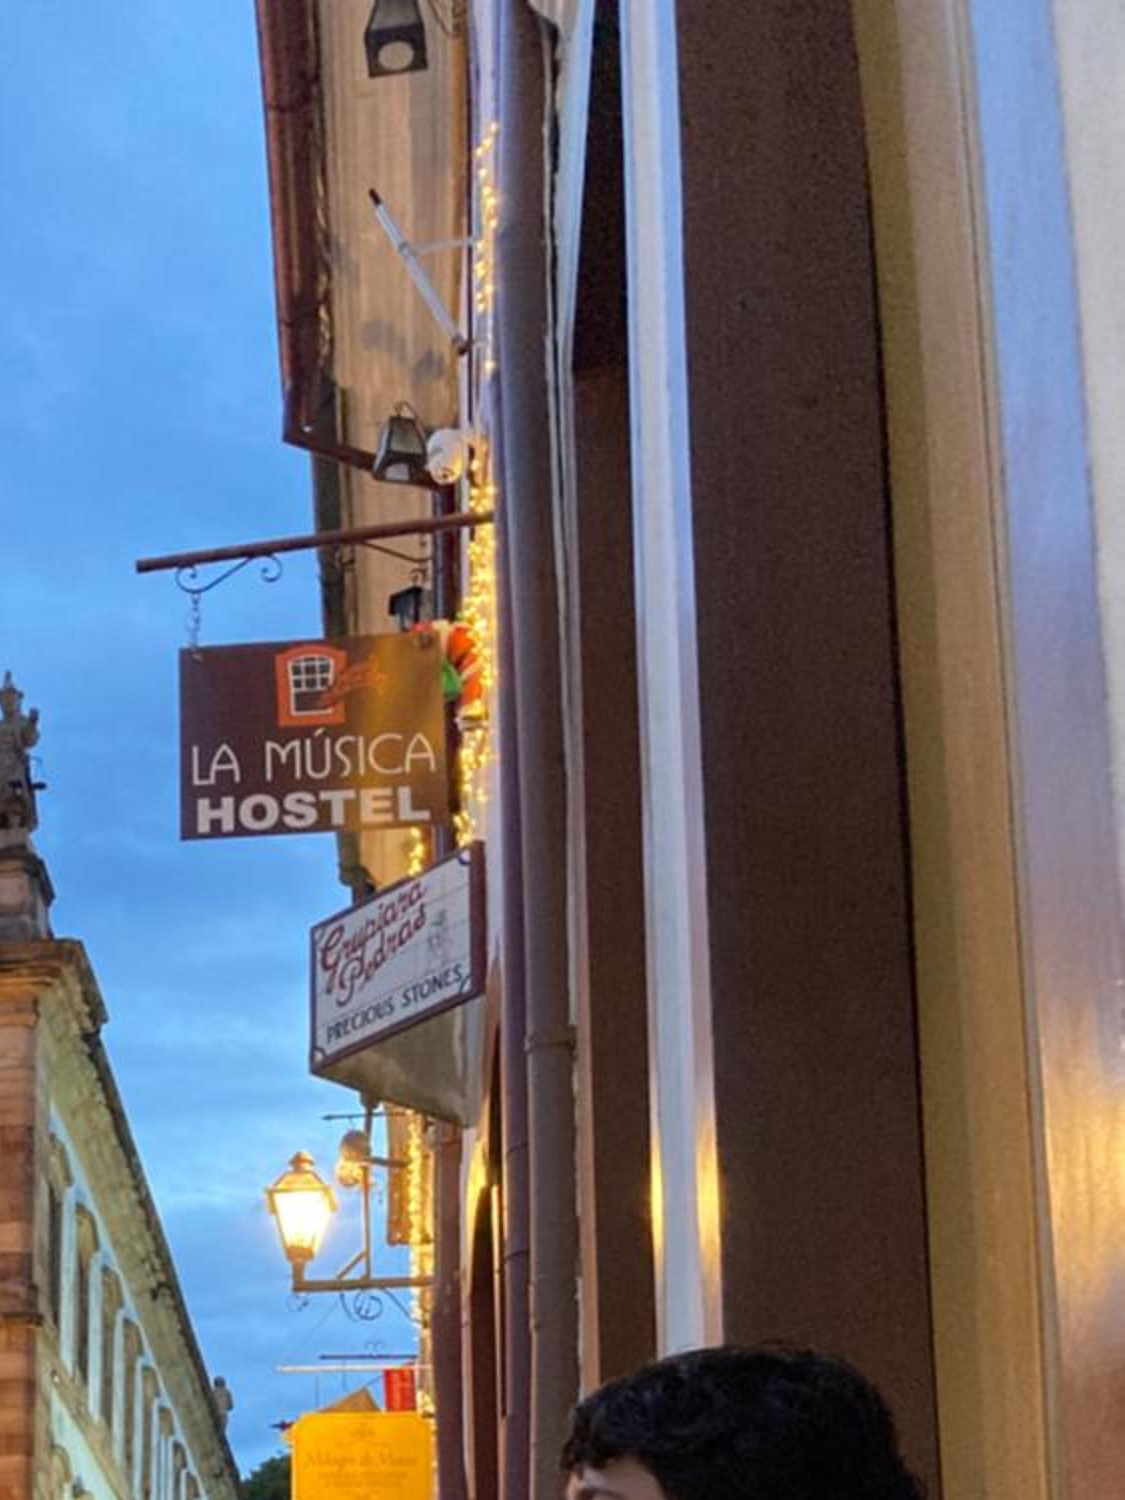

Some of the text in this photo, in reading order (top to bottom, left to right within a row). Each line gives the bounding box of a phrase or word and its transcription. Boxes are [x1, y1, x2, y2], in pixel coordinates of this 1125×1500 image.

[192, 728, 436, 785] LA MÚSICA
[196, 786, 431, 833] HOSTEL
[336, 903, 427, 1007] Pedras
[326, 963, 463, 1044] PRECIOUS STONES
